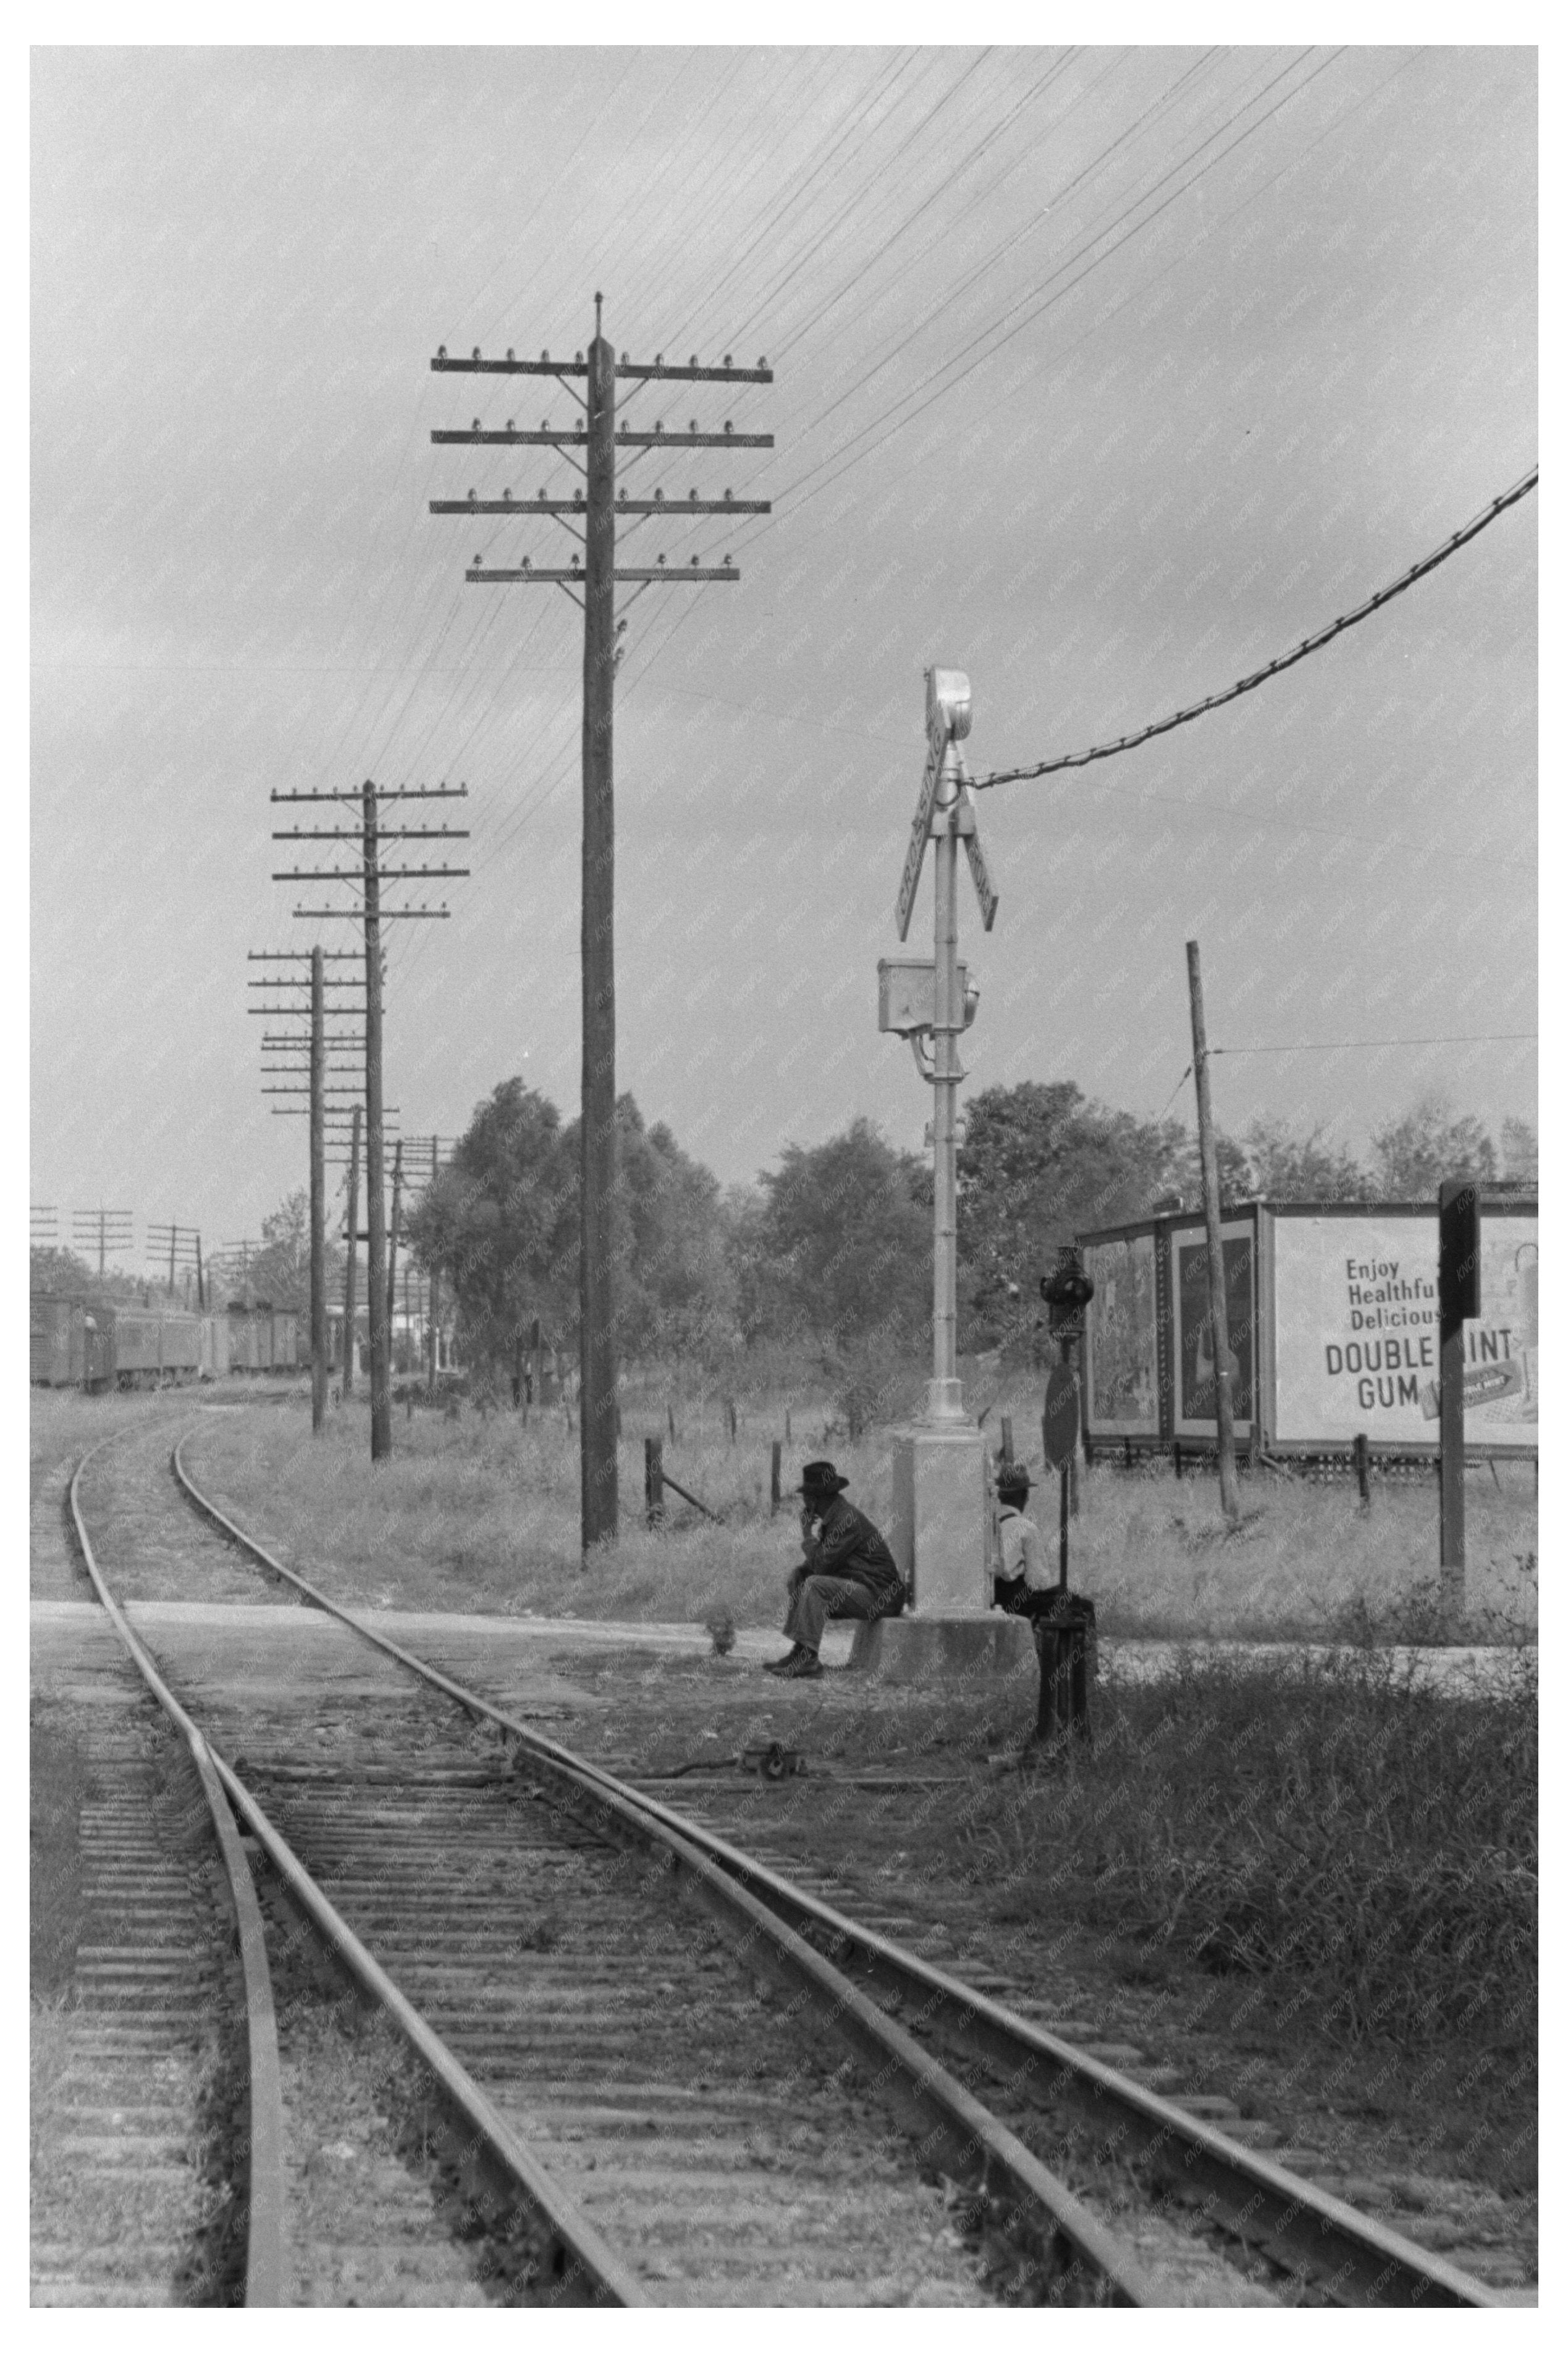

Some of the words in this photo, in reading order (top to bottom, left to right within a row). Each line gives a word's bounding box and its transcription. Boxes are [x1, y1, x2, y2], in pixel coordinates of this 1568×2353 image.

[1346, 1259, 1399, 1282] Enjoy
[1348, 1277, 1439, 1306] Healthfu
[1351, 1307, 1442, 1330] Delicious
[1359, 1374, 1419, 1409] GUM
